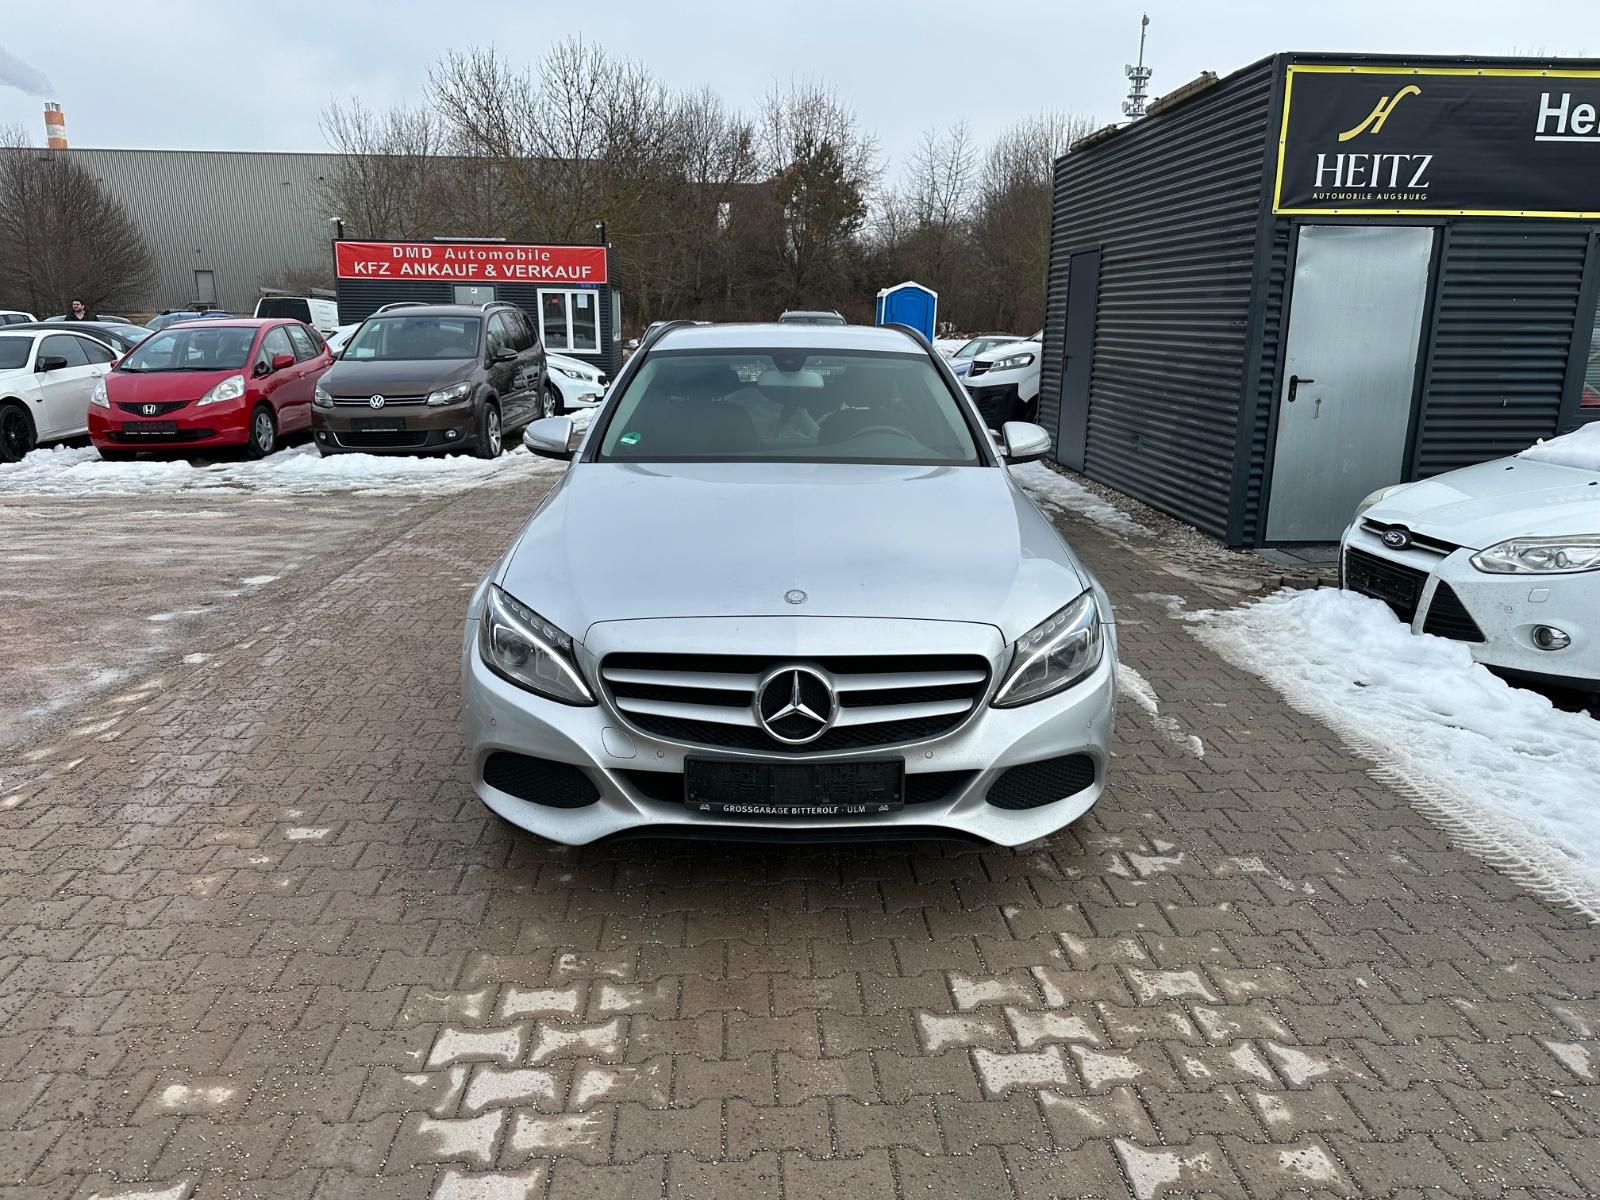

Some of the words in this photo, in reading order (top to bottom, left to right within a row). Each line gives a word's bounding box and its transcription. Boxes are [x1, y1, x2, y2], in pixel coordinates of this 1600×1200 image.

[1535, 92, 1600, 135] He
[1313, 153, 1434, 188] HEITZ
[1312, 192, 1372, 201] AUTOMOBILE
[1376, 193, 1428, 201] AUGSBURG
[392, 246, 433, 259] DMD
[444, 247, 551, 261] Automobile
[353, 261, 391, 275] KFZ
[400, 262, 479, 277] ANKAUF
[484, 265, 498, 277] &
[502, 264, 592, 279] VERKAUF
[723, 804, 789, 815] GROSSGARAGE
[791, 806, 839, 815] BITTEROLF
[847, 805, 866, 813] ULM
